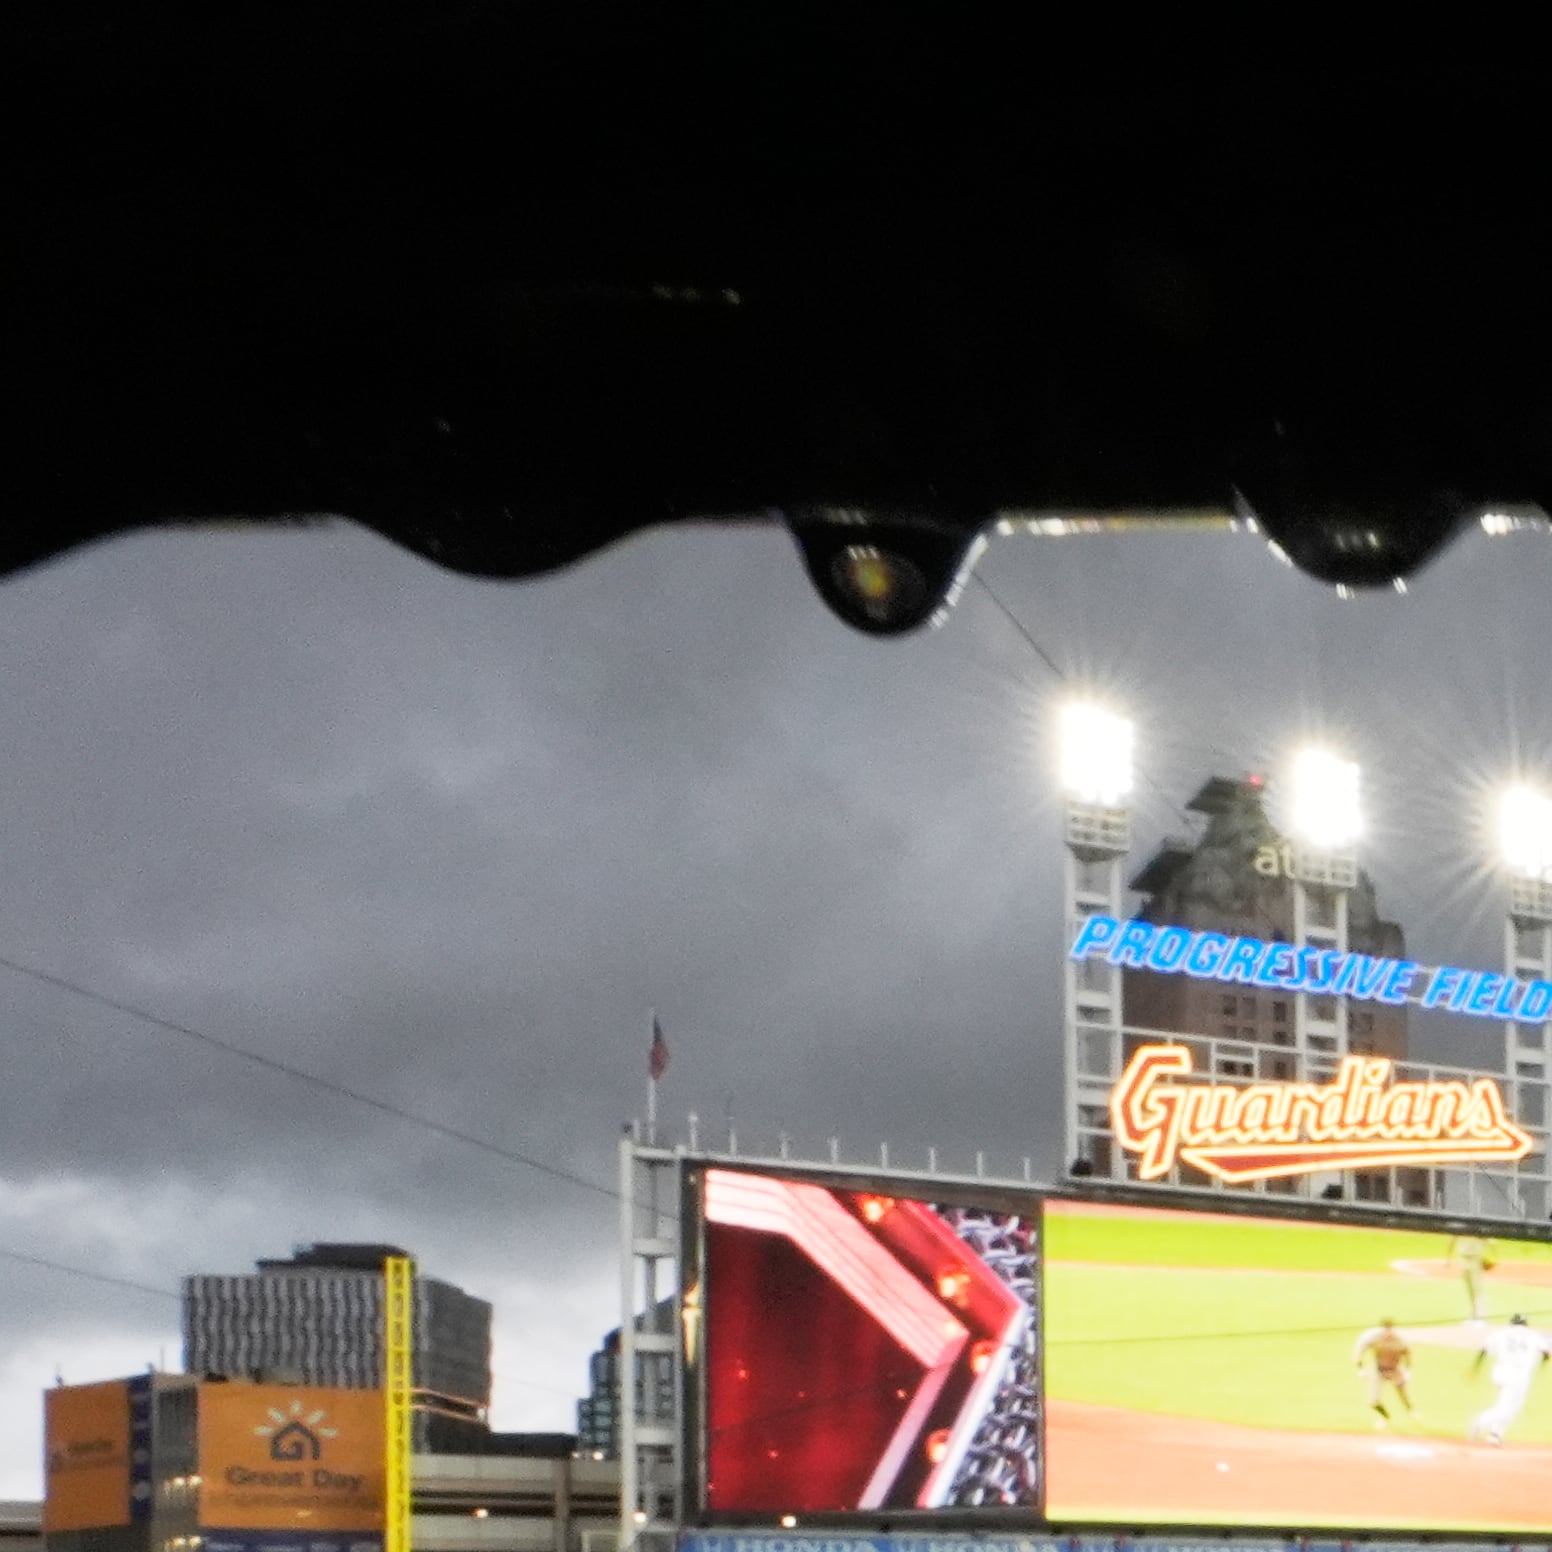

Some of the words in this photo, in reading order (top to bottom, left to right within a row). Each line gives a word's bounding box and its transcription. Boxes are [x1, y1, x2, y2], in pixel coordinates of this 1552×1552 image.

[1070, 914, 1421, 1004] PROGRESSIVE
[1112, 1045, 1534, 1182] Guardians
[314, 1469, 365, 1492] Day
